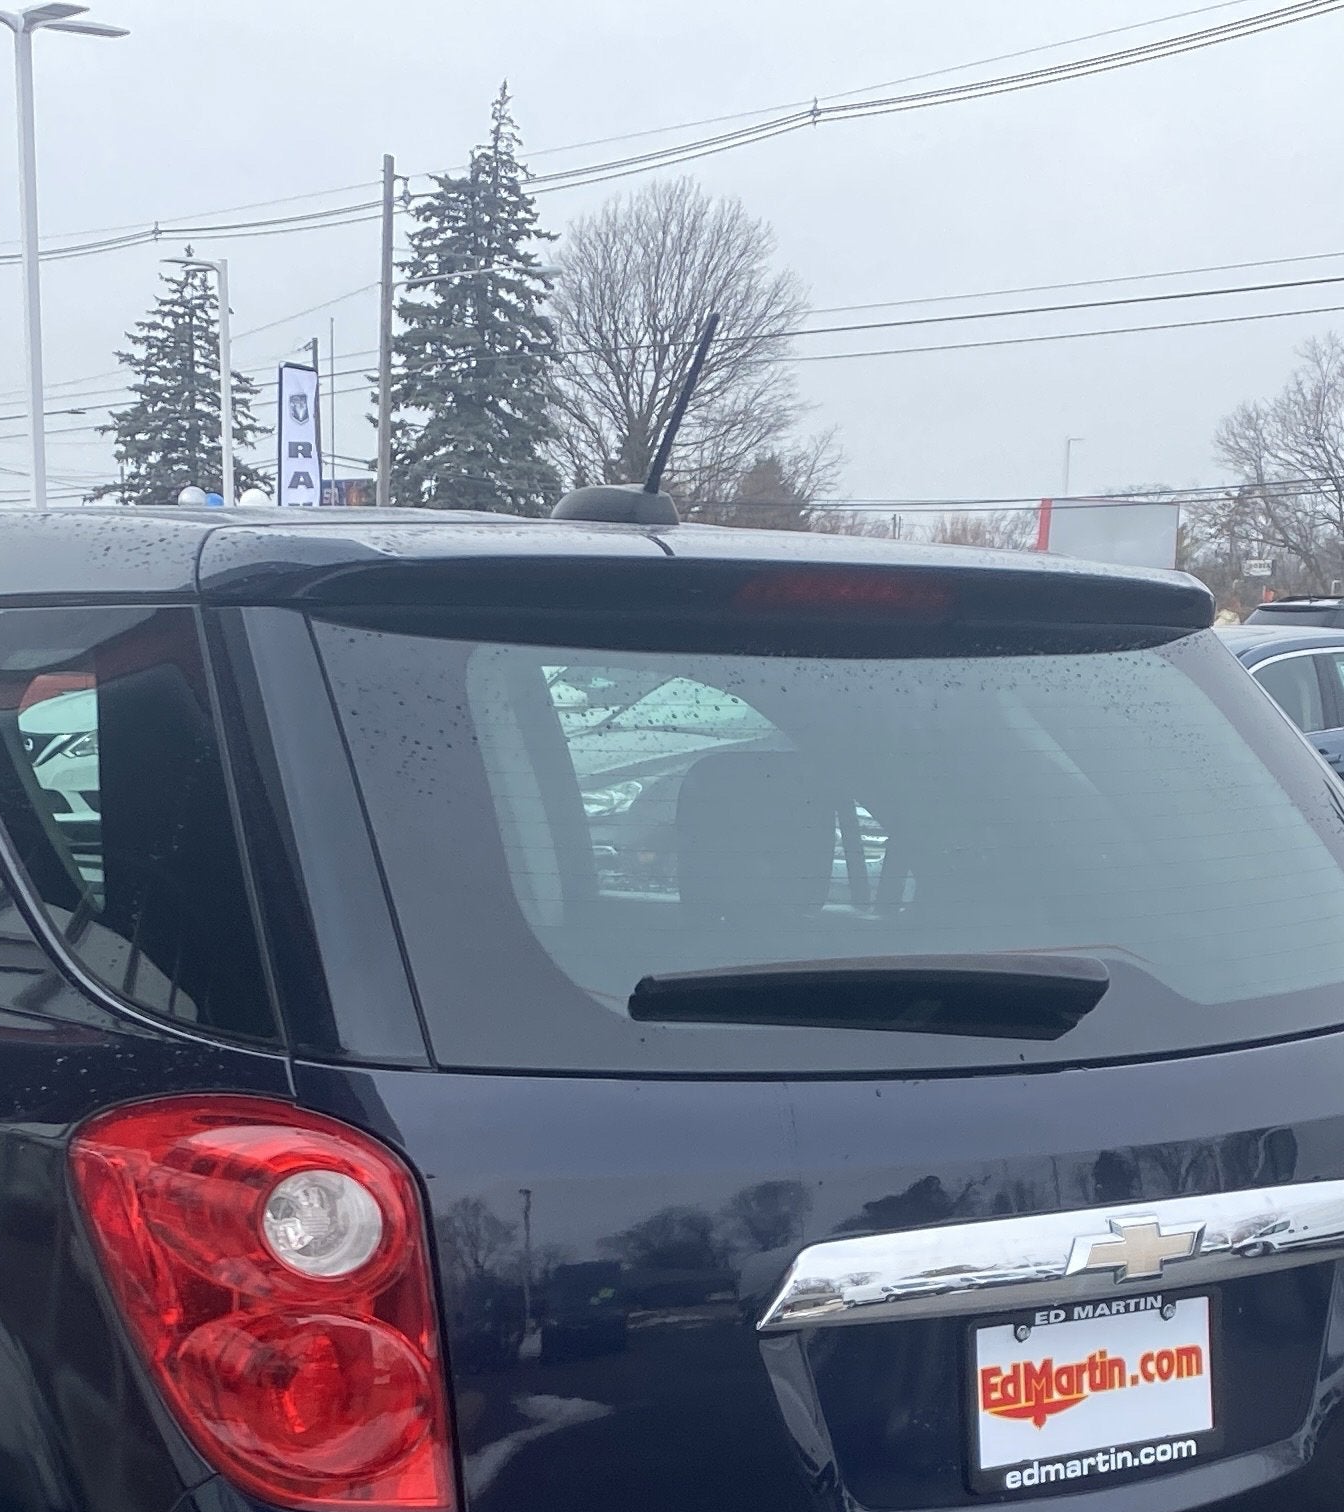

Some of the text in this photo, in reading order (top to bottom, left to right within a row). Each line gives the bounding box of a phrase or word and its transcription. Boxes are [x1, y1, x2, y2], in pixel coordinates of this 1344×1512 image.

[288, 441, 314, 506] RA
[1034, 1295, 1162, 1326] ED MARTIN
[980, 1344, 1203, 1414] EdMartin.com
[1005, 1439, 1197, 1489] edmartin.com
